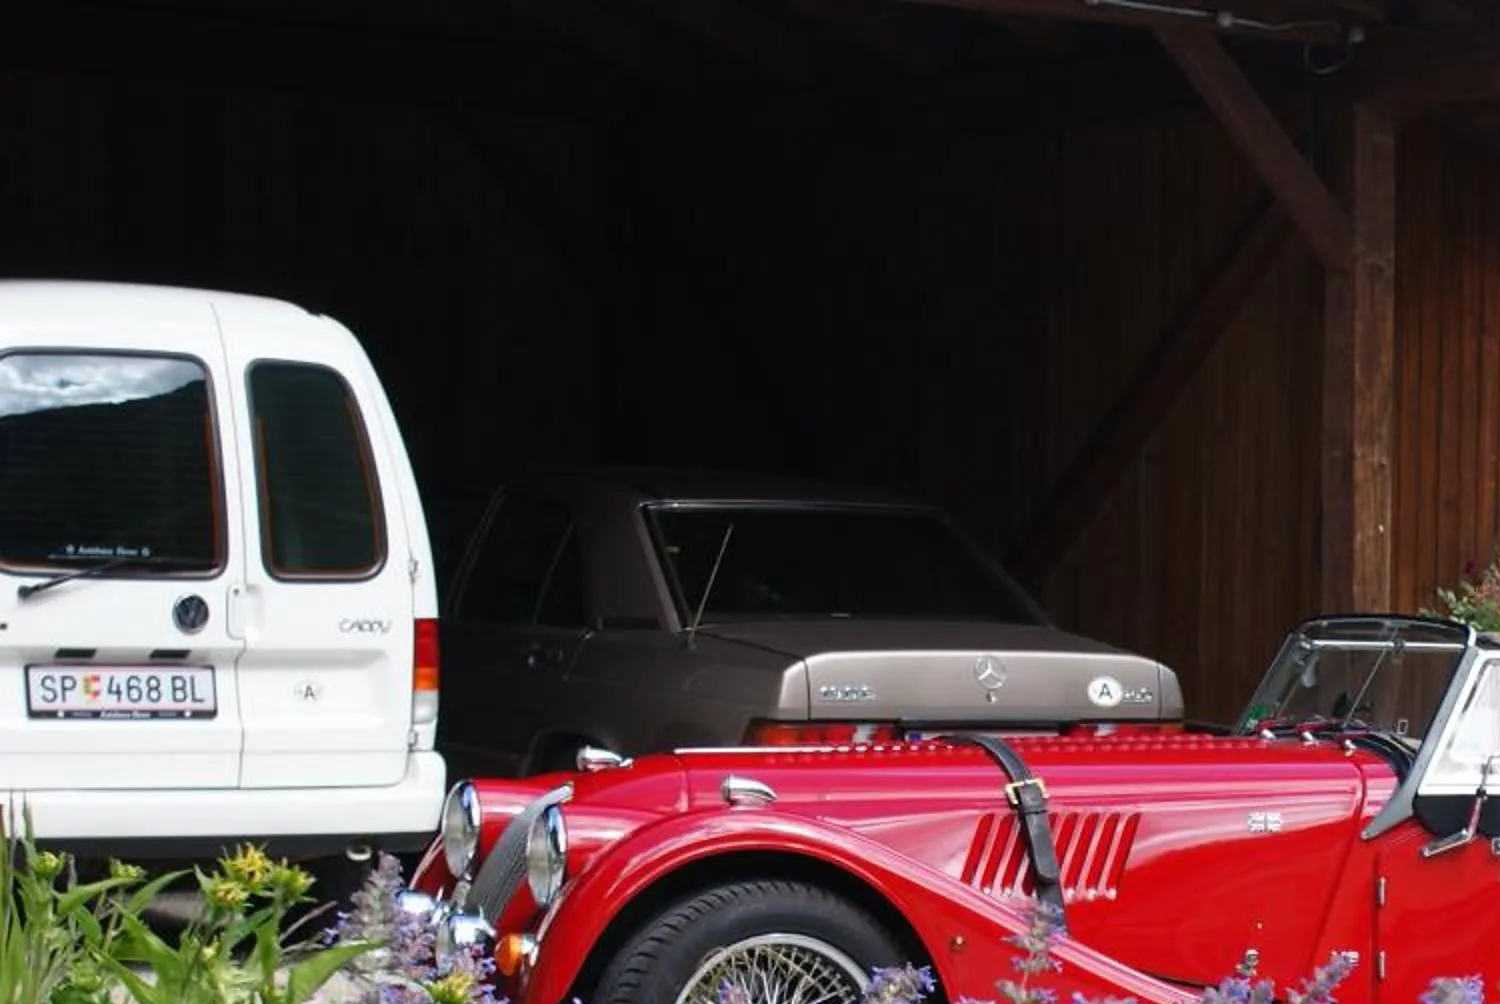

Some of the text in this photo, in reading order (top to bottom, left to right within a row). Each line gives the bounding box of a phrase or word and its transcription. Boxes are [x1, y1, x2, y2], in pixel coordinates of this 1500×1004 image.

[41, 675, 204, 703] SP 468 BL
[304, 684, 317, 700] A
[1098, 682, 1113, 700] A
